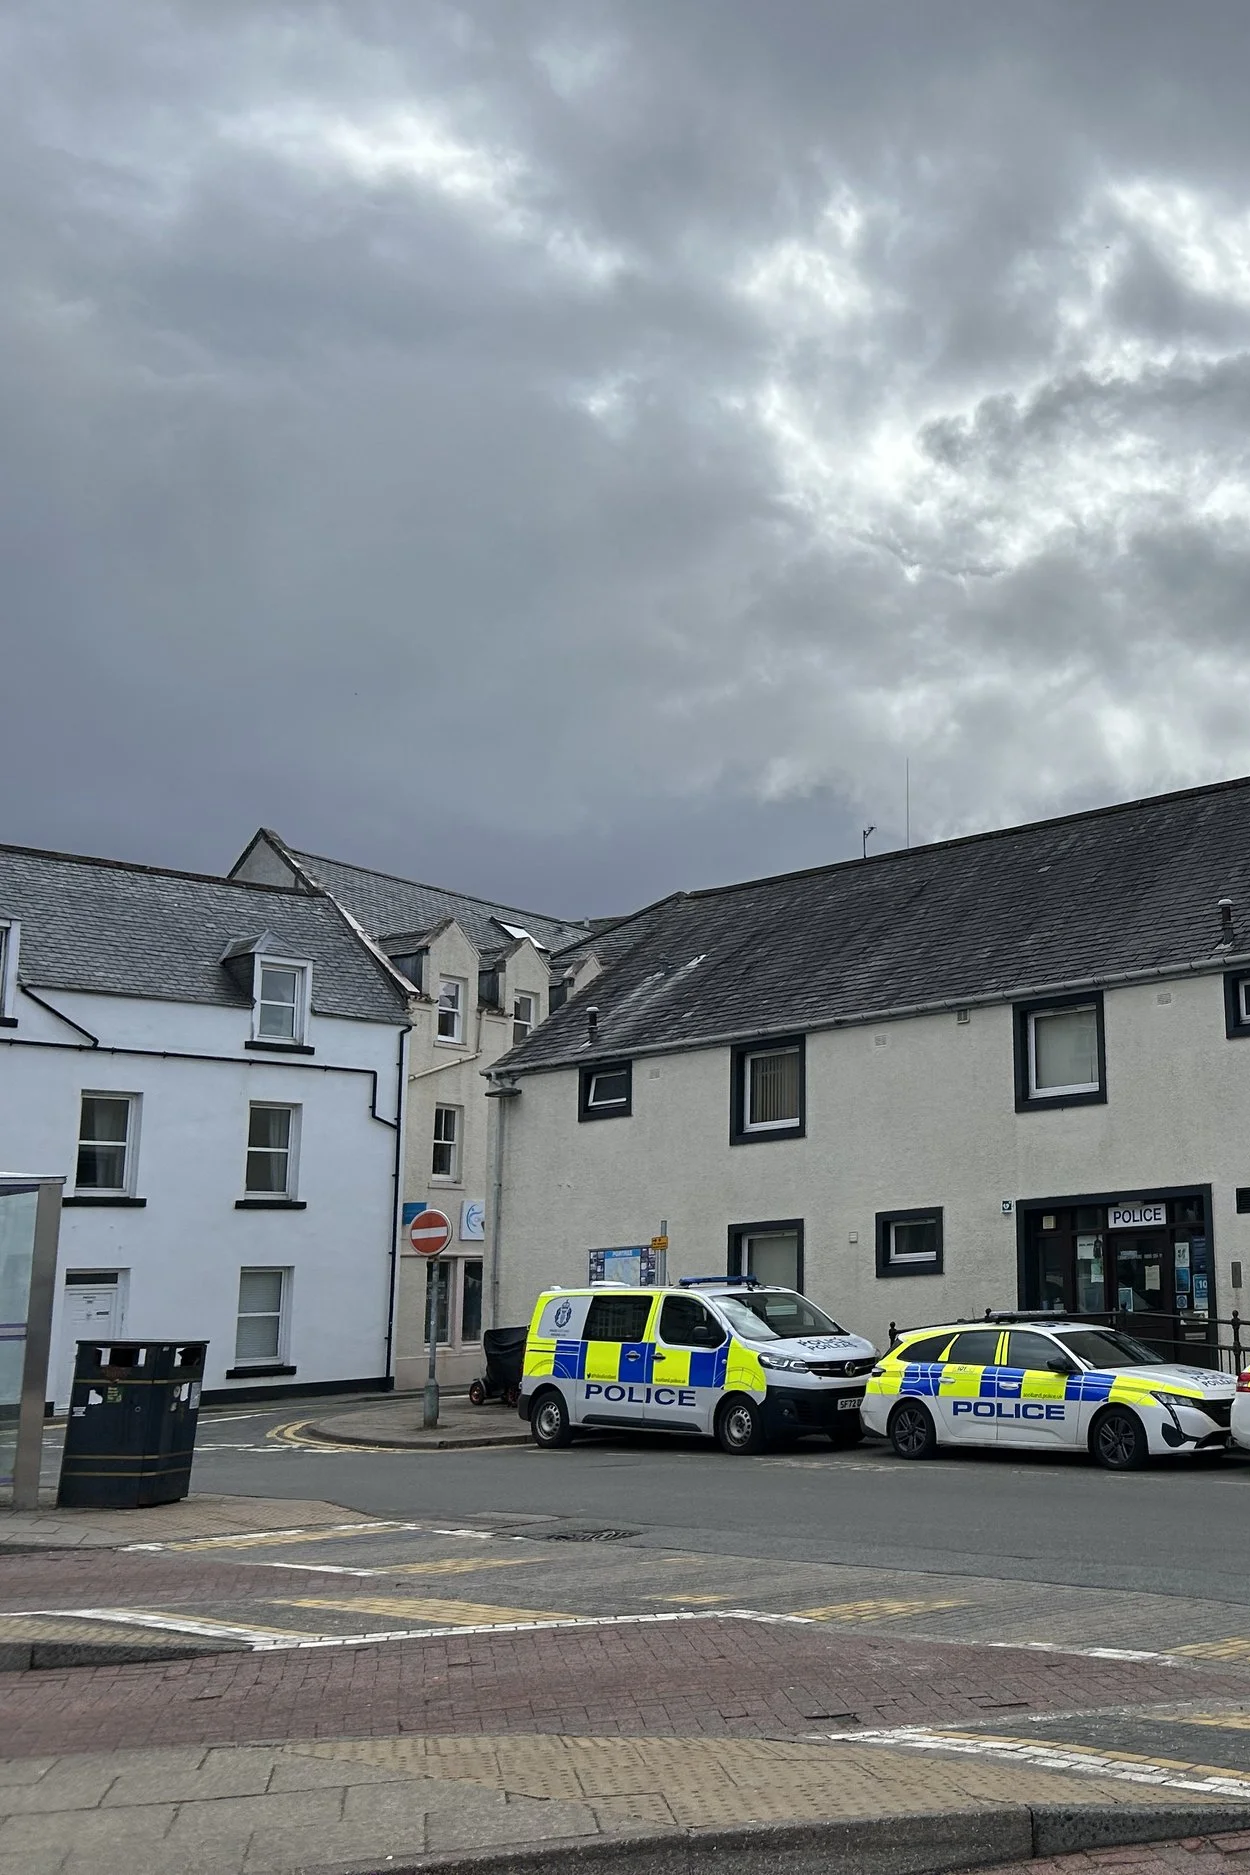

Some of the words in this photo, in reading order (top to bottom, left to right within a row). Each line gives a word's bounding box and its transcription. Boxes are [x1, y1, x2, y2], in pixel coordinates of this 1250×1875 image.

[1113, 1208, 1161, 1224] POLICE
[585, 1383, 697, 1407] POLICE
[952, 1400, 1066, 1421] POLICE
